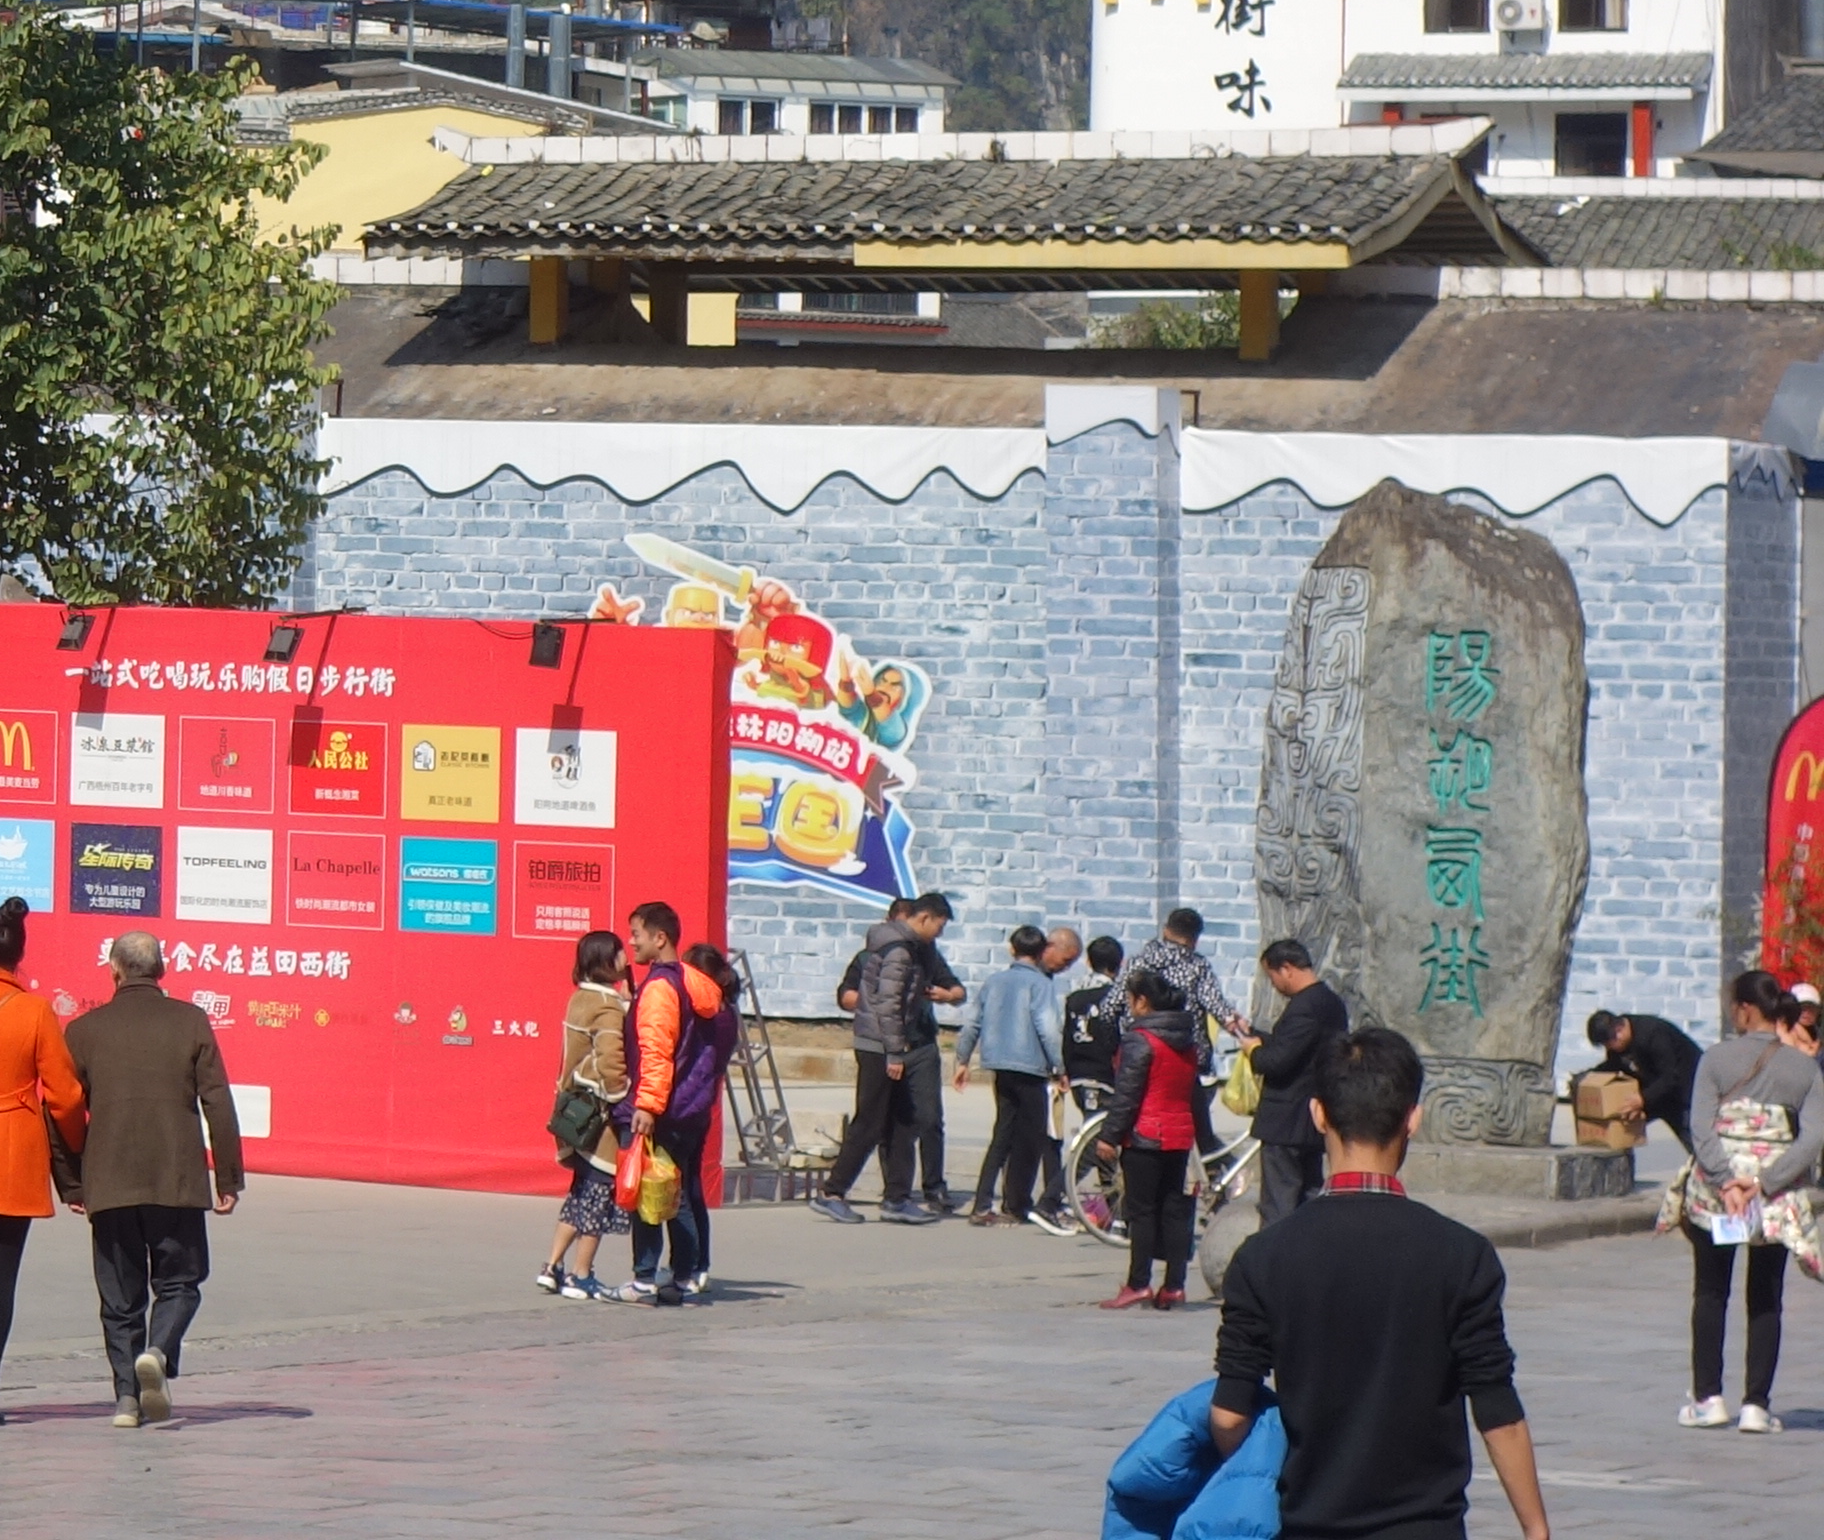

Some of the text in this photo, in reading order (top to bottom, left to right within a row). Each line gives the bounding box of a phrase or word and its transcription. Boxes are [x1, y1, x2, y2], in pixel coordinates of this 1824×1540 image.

[65, 658, 395, 698] 一站式吃喝玩乐购假日步行街
[730, 713, 853, 769] 林阳朔站
[308, 750, 369, 770] 人民公社
[183, 856, 267, 870] TOPFEELING
[293, 858, 380, 877] La Chapelle
[410, 867, 459, 878] watsons
[528, 860, 601, 883] 铂爵旅拍
[84, 884, 145, 898] 专为儿童设计的
[97, 937, 351, 980] 更食尽在益田西街
